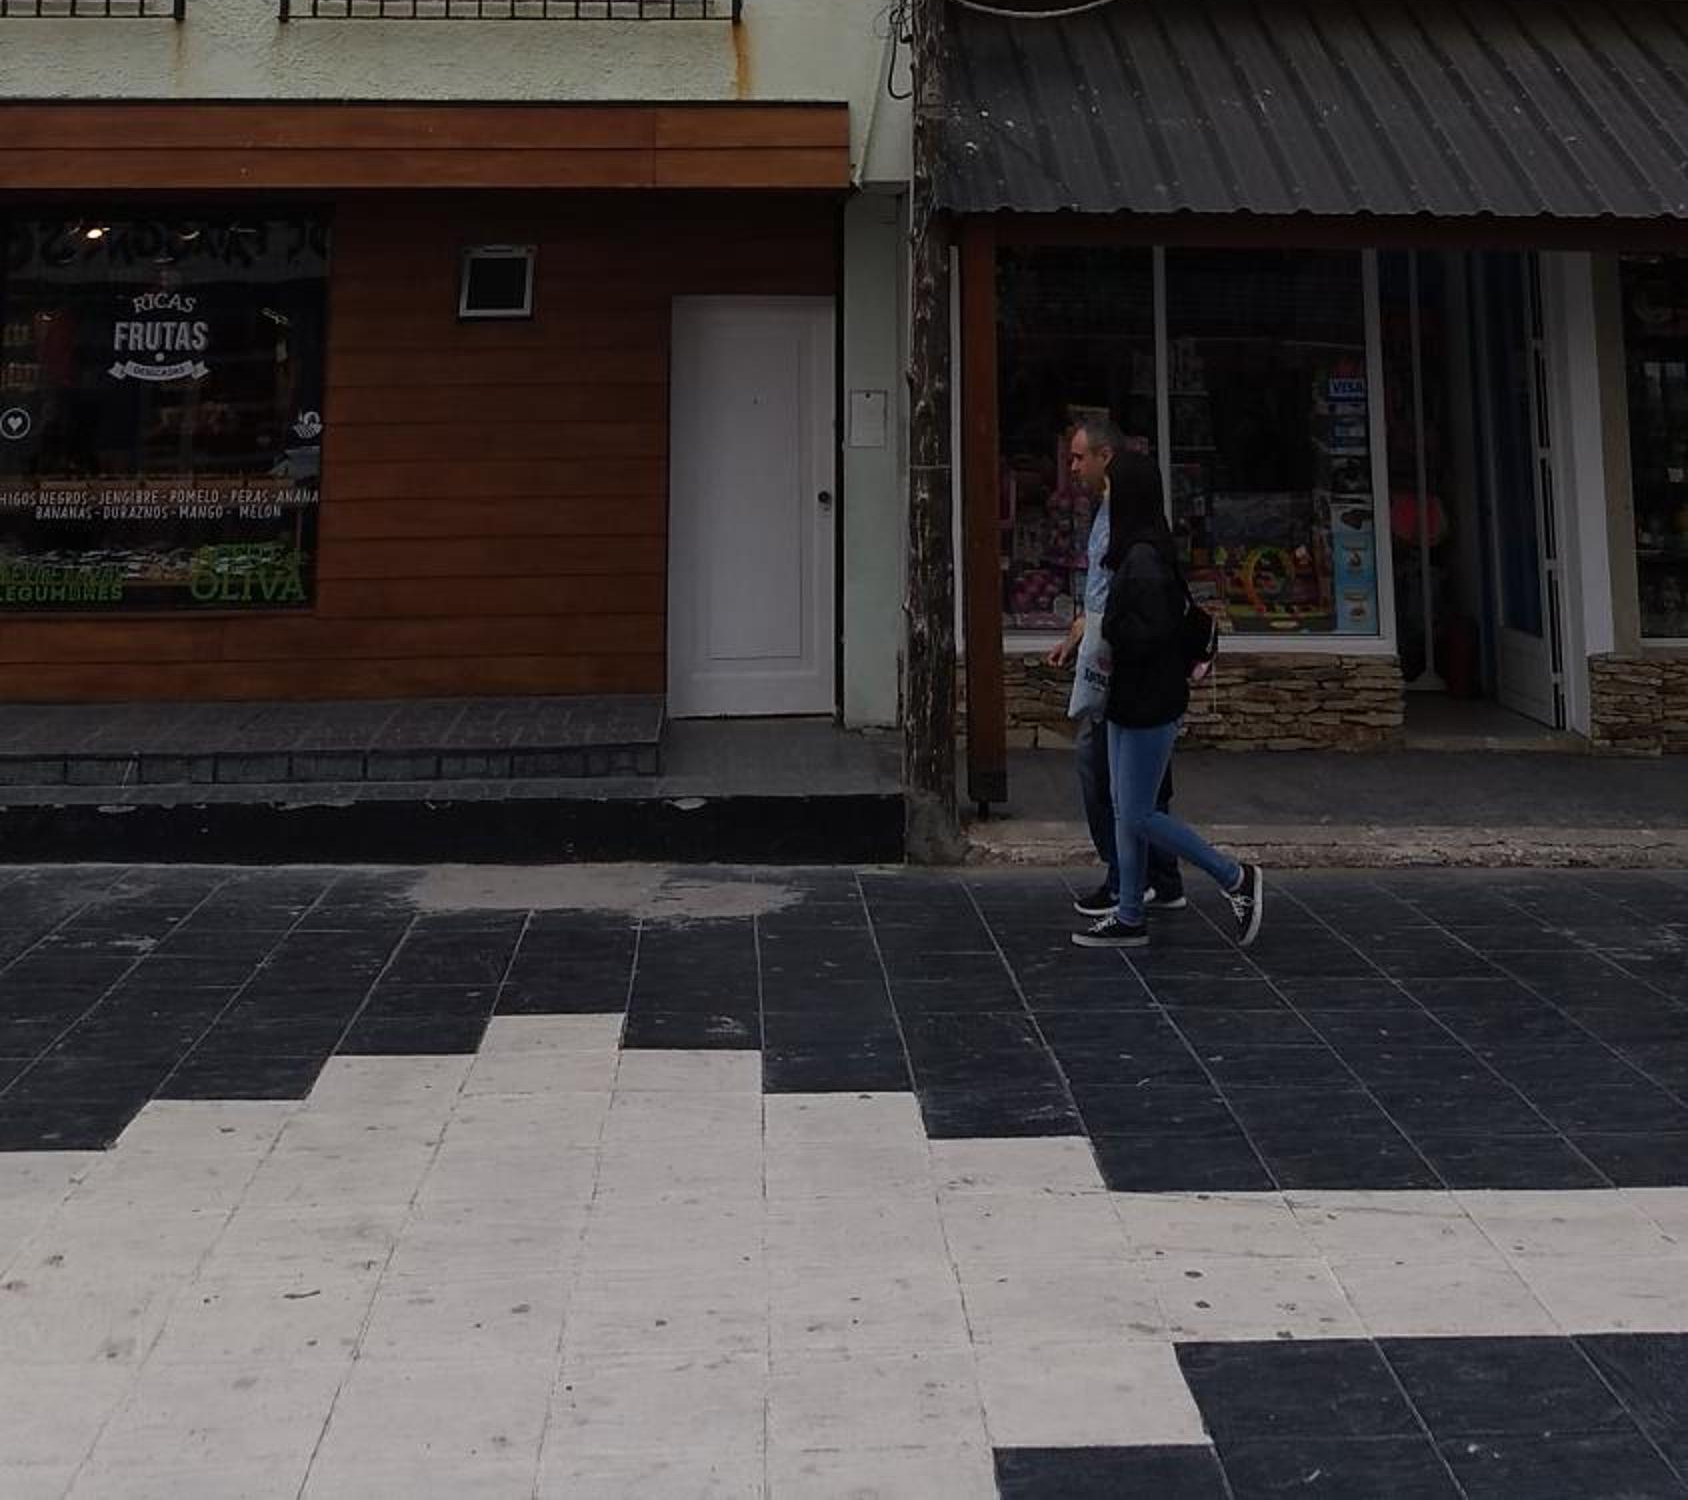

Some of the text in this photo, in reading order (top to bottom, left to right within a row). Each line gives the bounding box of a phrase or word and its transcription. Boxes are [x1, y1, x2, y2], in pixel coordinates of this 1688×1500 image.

[132, 292, 197, 314] RICAS
[113, 320, 209, 352] FRUTAS
[1334, 381, 1363, 393] VISA
[39, 490, 88, 506] NEGROS
[98, 489, 160, 505] JENGIBRE
[170, 489, 219, 503] POMELO
[231, 489, 270, 503] PERAS
[35, 505, 93, 520] BANANAS
[103, 505, 169, 520] DURAZNOS
[179, 504, 223, 519] MANGO
[191, 569, 308, 602] OLIVA
